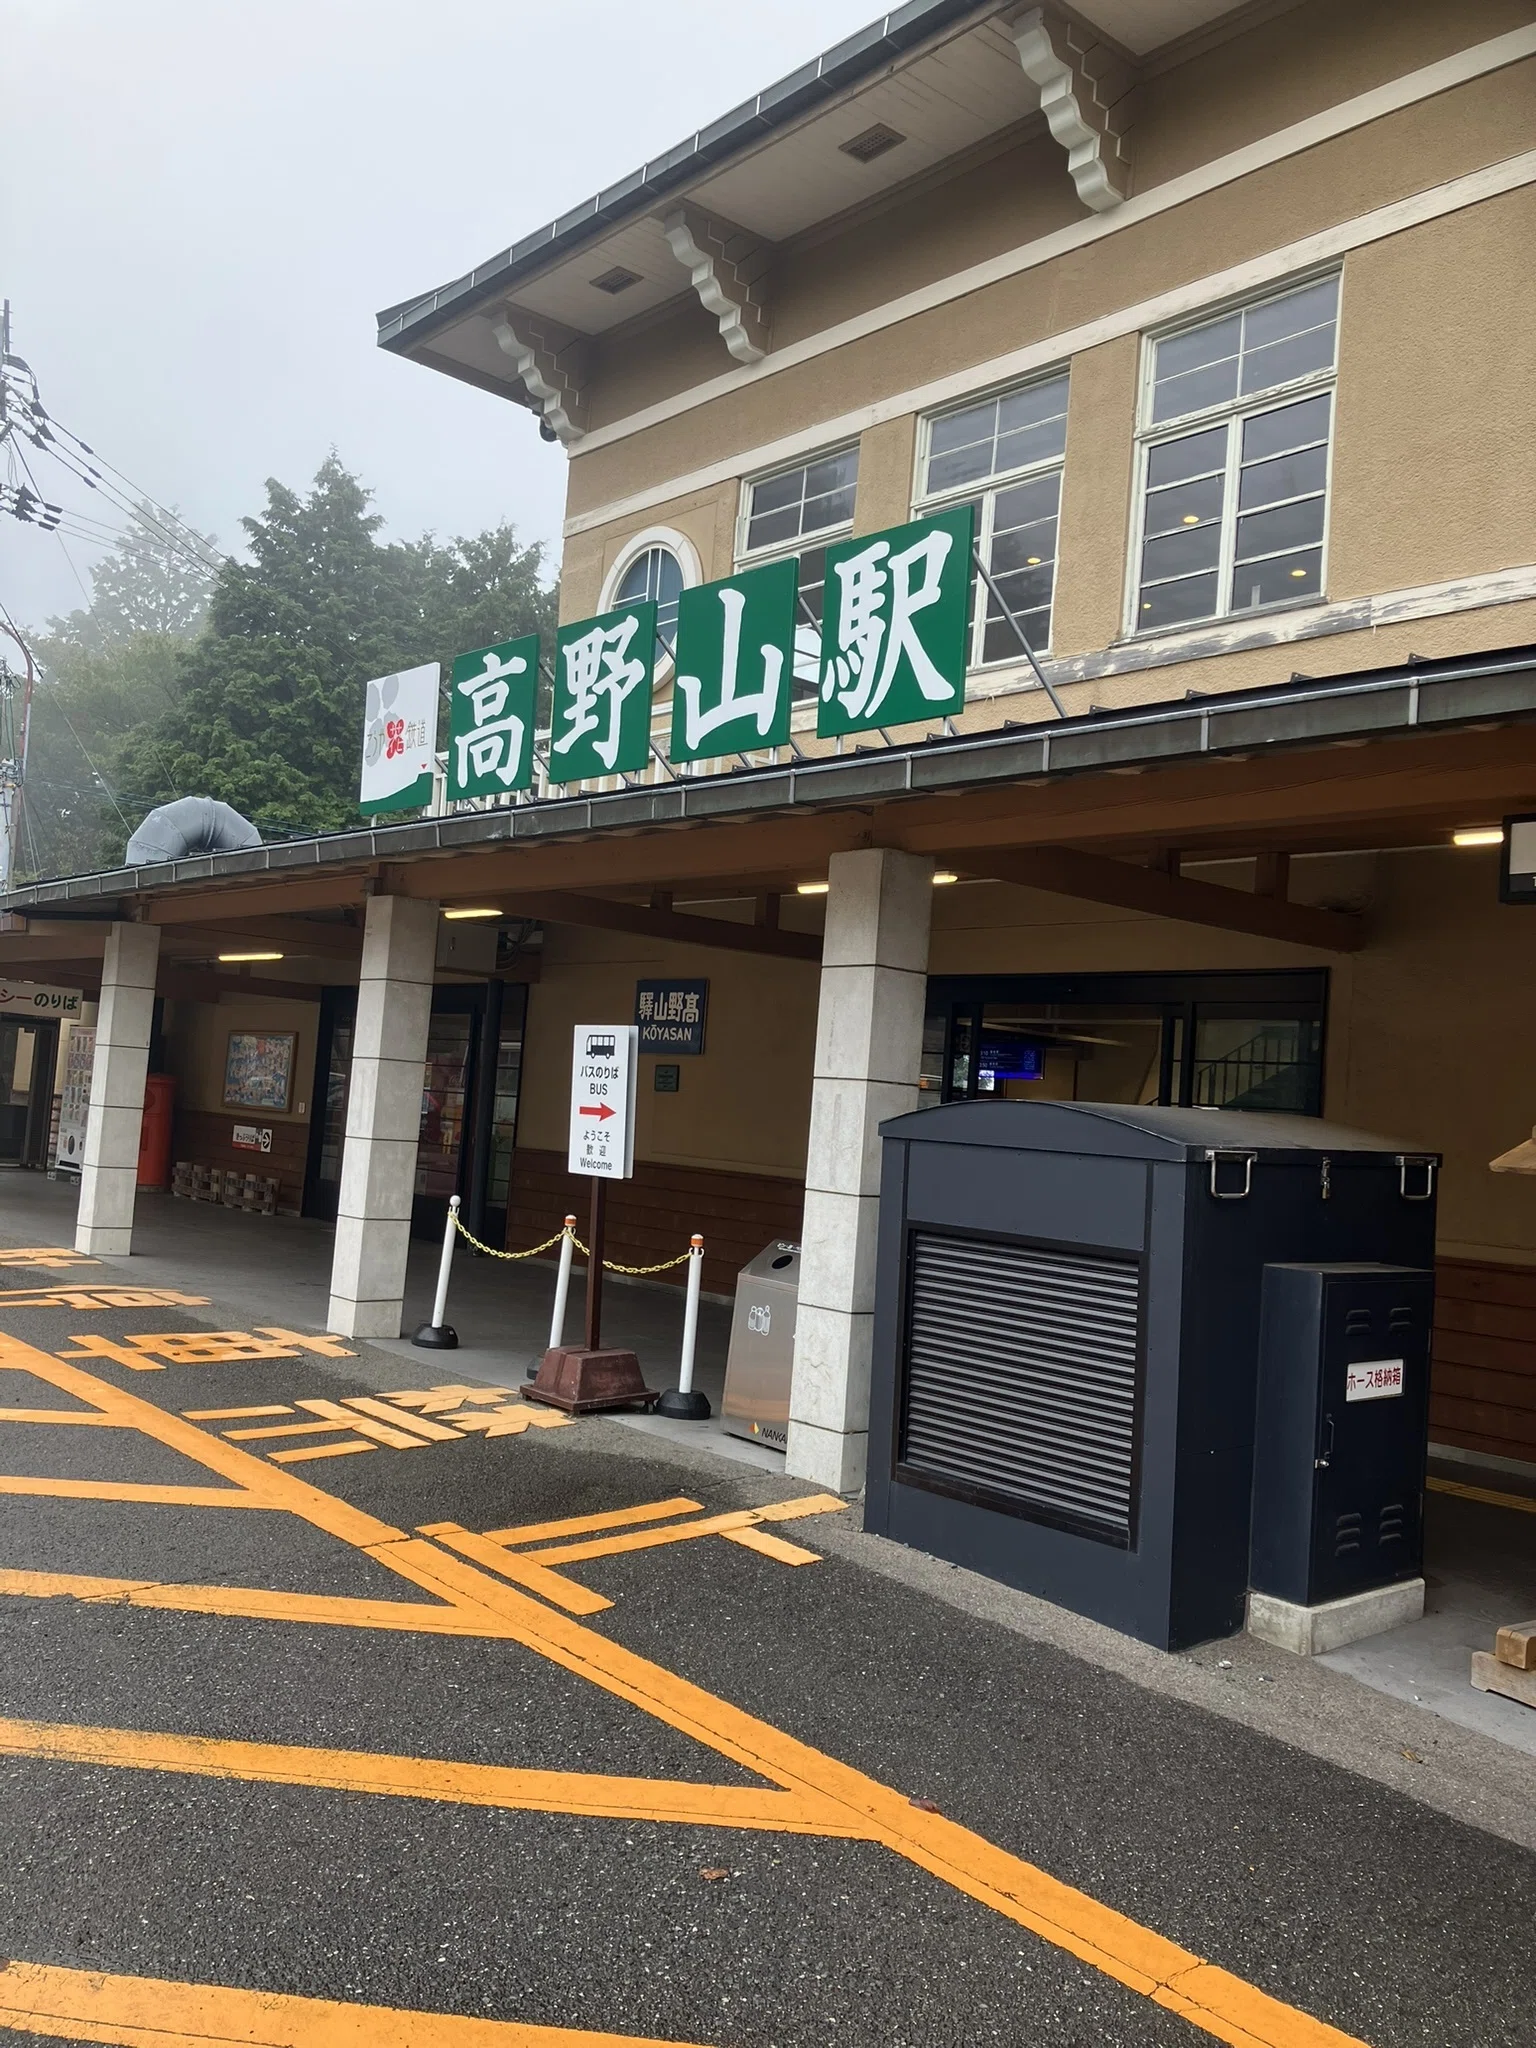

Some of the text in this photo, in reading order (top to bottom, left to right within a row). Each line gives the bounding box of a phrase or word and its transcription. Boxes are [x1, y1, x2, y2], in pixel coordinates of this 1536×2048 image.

[454, 529, 957, 789] 高野山駅
[580, 1066, 620, 1080] バスのりば
[589, 1083, 608, 1096] BUS
[583, 1130, 611, 1143] ようこそ
[579, 1157, 613, 1171] Welcome
[1347, 1367, 1402, 1391] ホース格納箱
